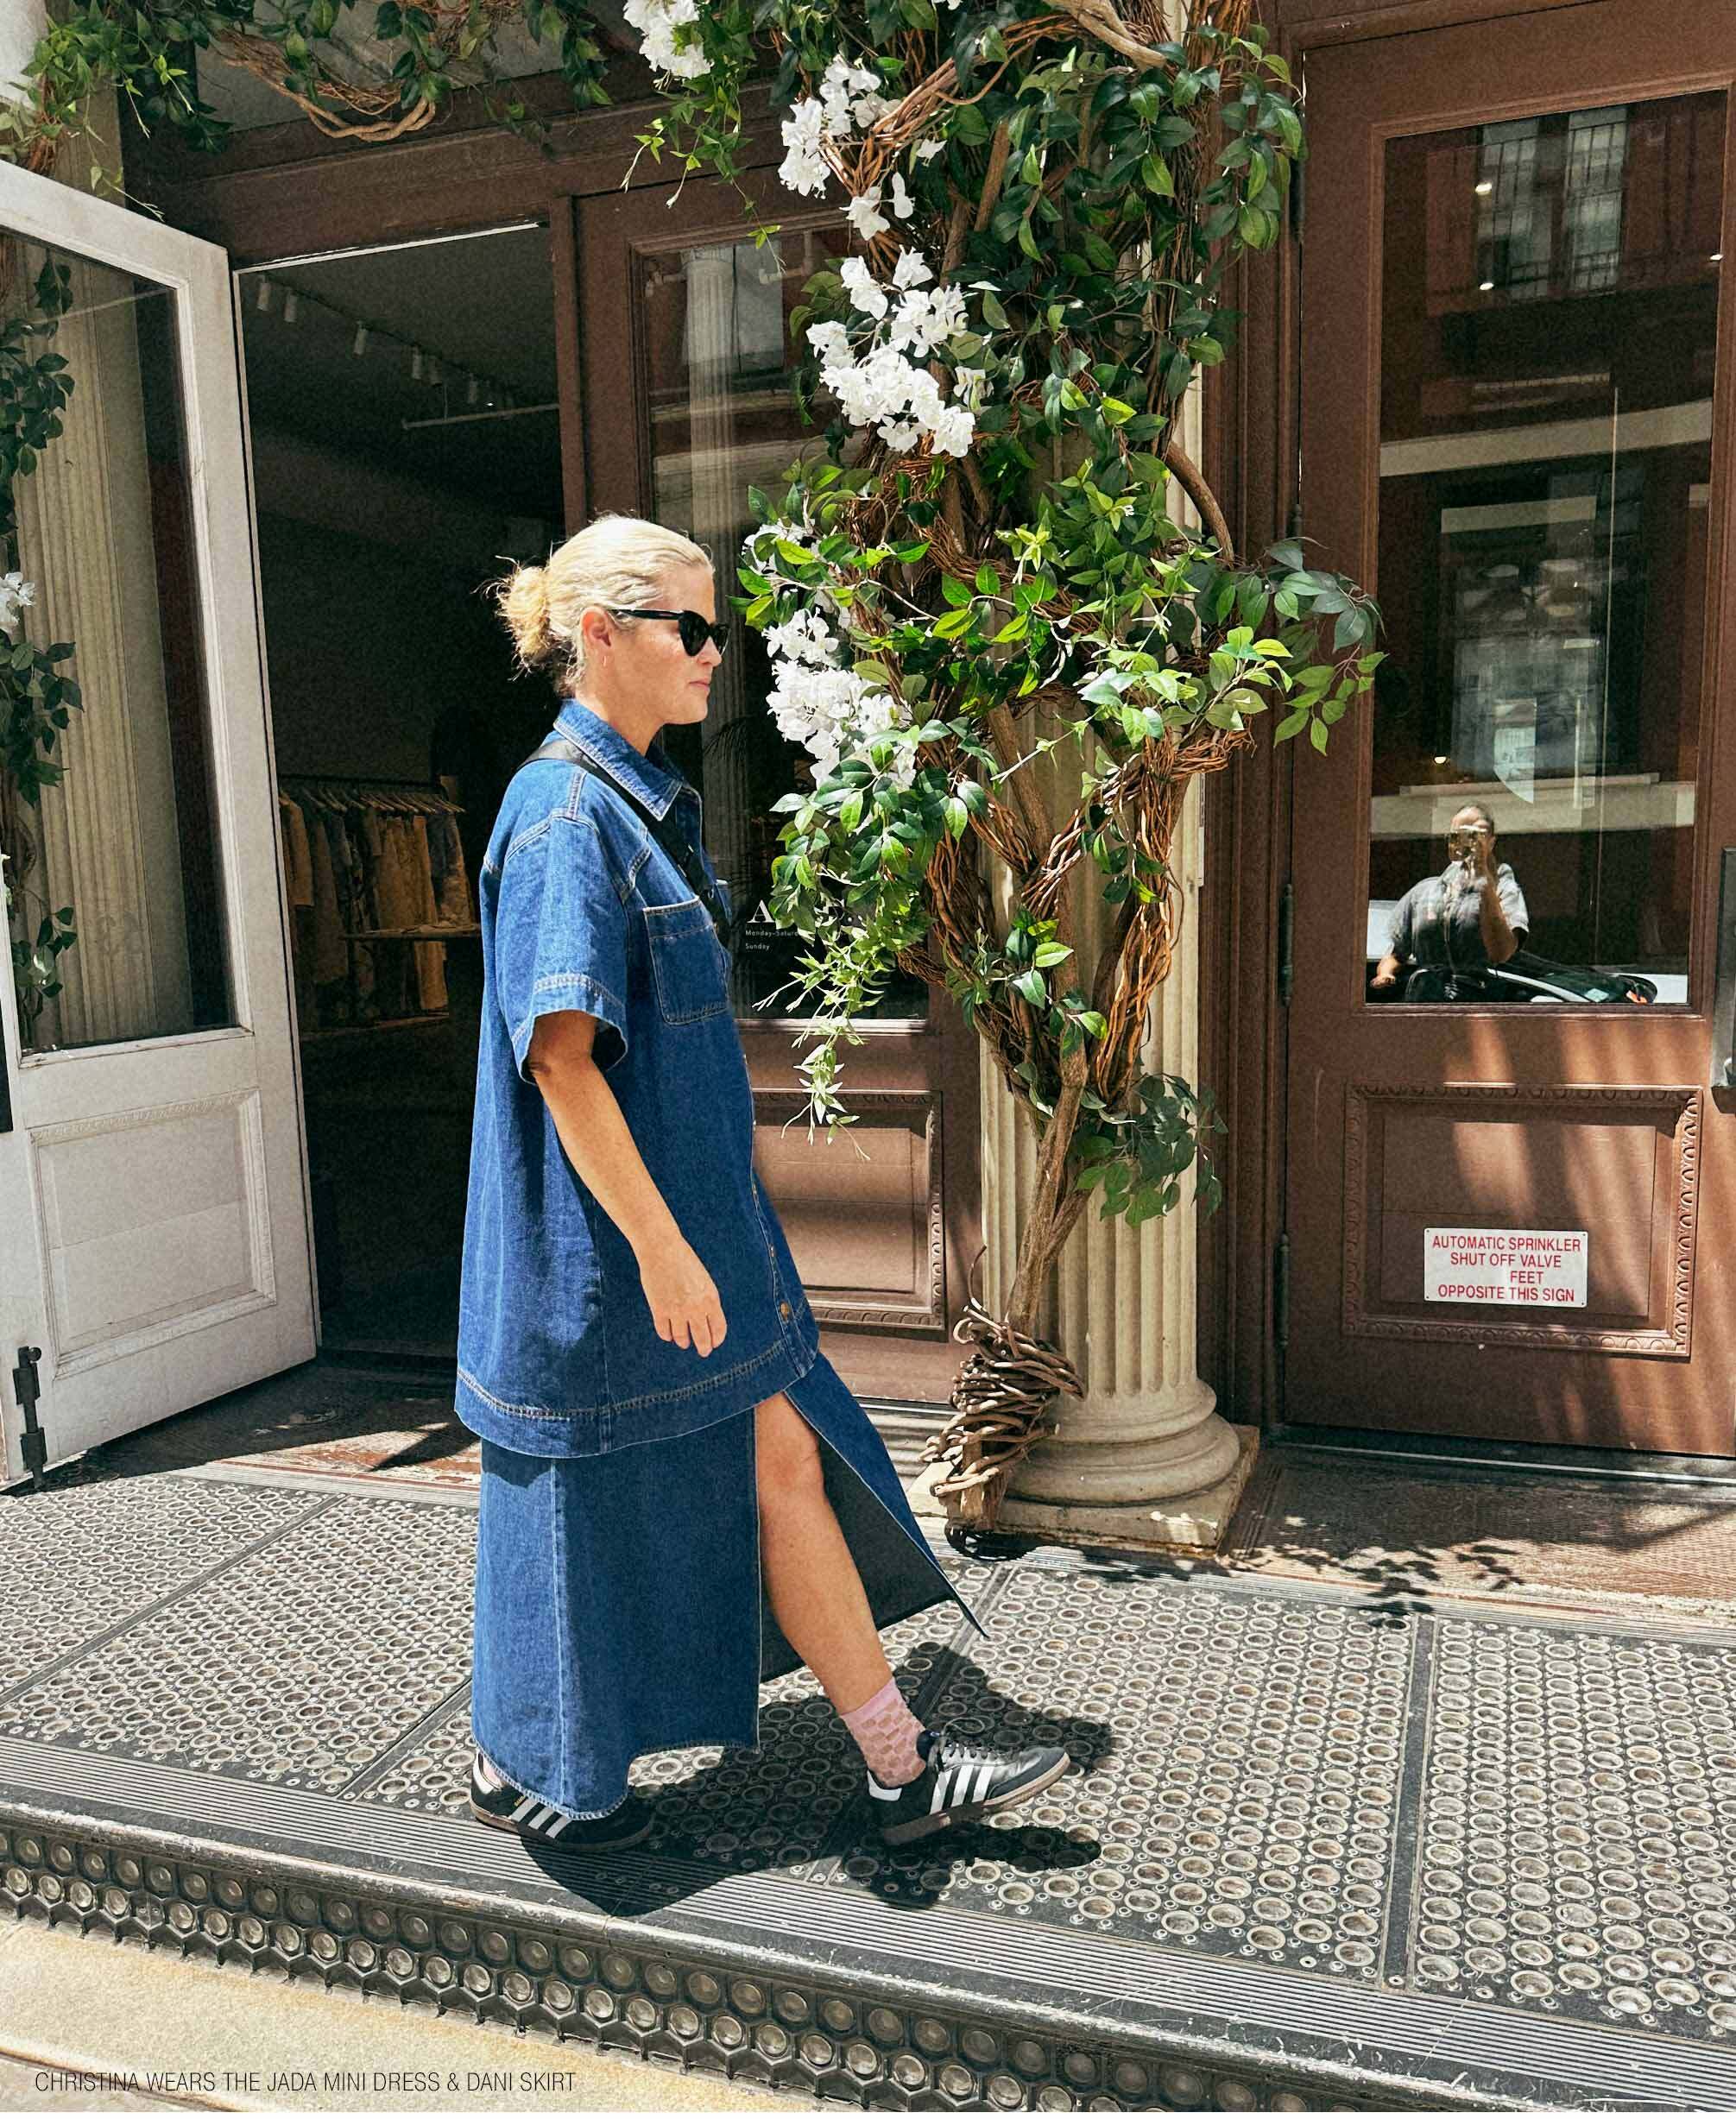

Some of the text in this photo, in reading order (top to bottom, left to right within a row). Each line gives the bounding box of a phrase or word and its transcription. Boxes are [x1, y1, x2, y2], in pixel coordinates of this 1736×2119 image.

[745, 930, 799, 938] Monday-Saturd
[1432, 1235, 1581, 1252] AUTOMATIC SPRINKLER
[1450, 1252, 1562, 1268] SHUT OFF VALVE
[1510, 1271, 1543, 1284] FEET
[1437, 1284, 1575, 1302] OPPOSITE THIS SIGN
